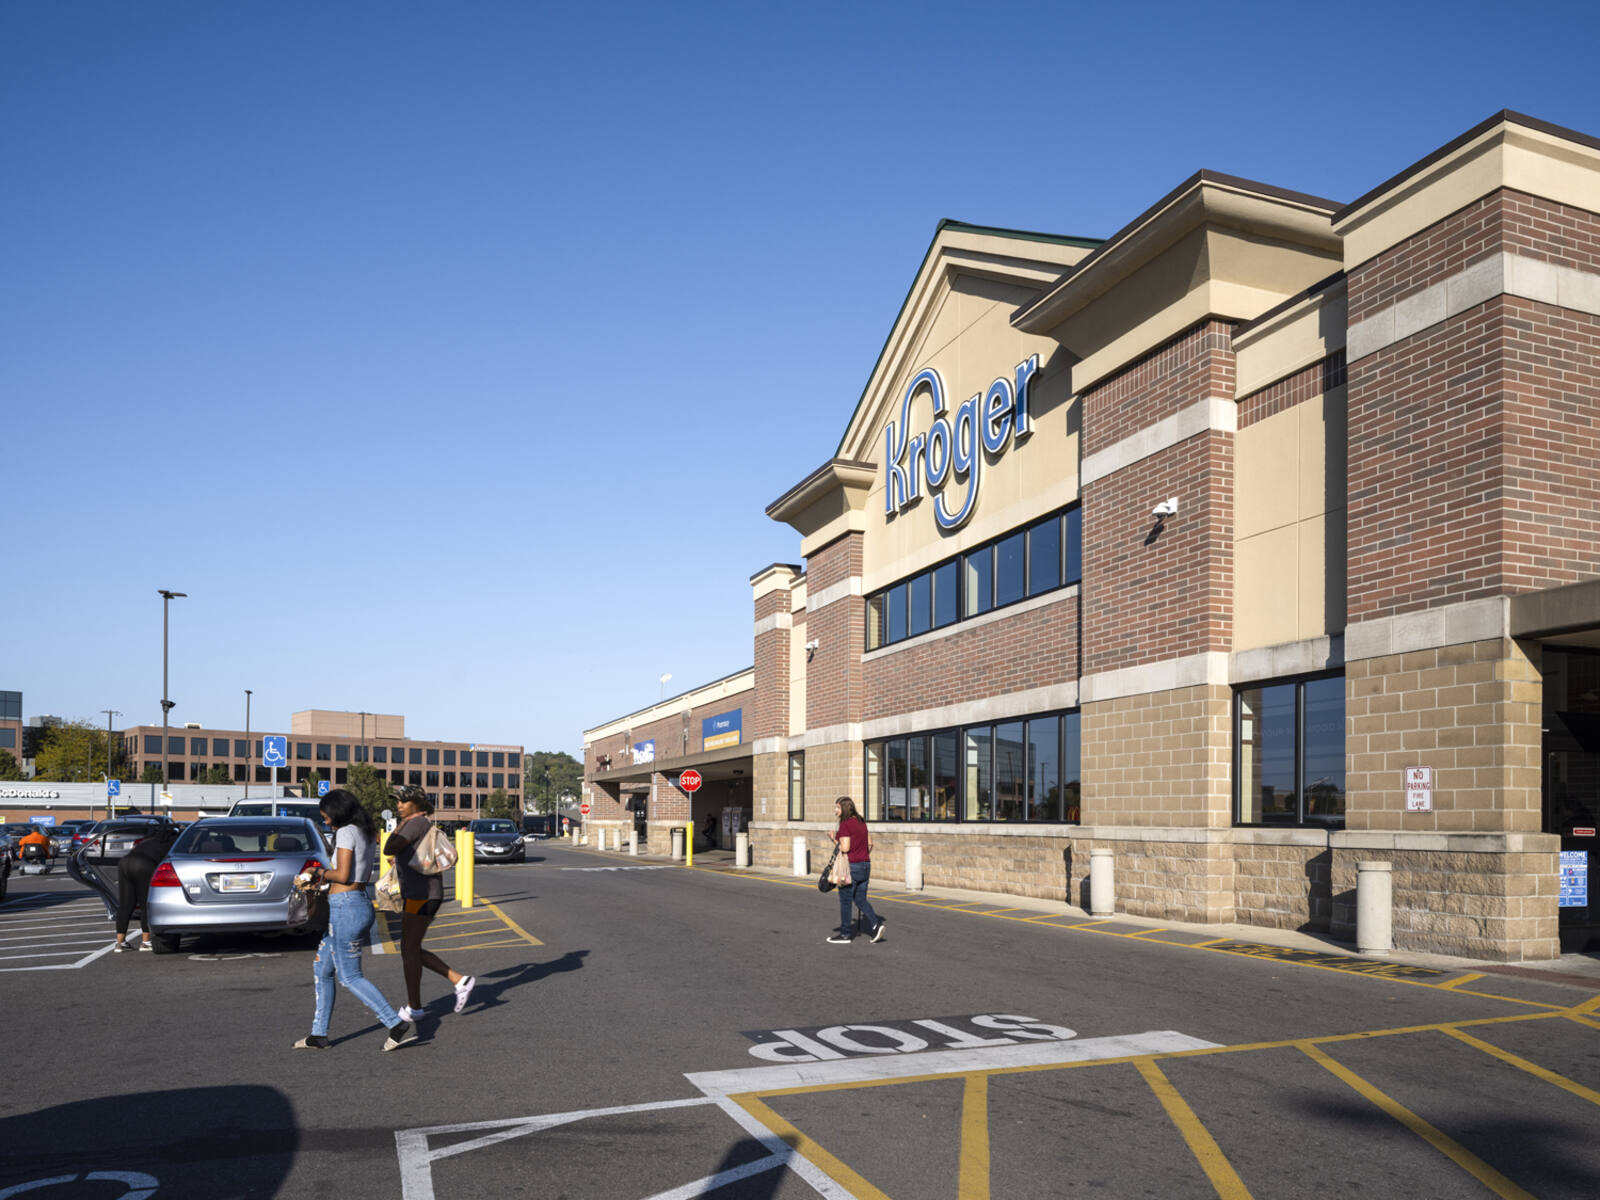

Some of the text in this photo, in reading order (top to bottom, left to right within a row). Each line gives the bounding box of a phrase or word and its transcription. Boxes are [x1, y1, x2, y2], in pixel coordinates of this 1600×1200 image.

[885, 353, 1040, 530] Kroger
[1412, 771, 1424, 780] NO
[681, 776, 700, 785] STOP
[1407, 782, 1430, 790] PARKING
[0, 789, 60, 799] cDonald's
[1412, 792, 1424, 800] FIRE
[1411, 800, 1425, 808] LANE
[748, 1013, 1078, 1063] STOP
